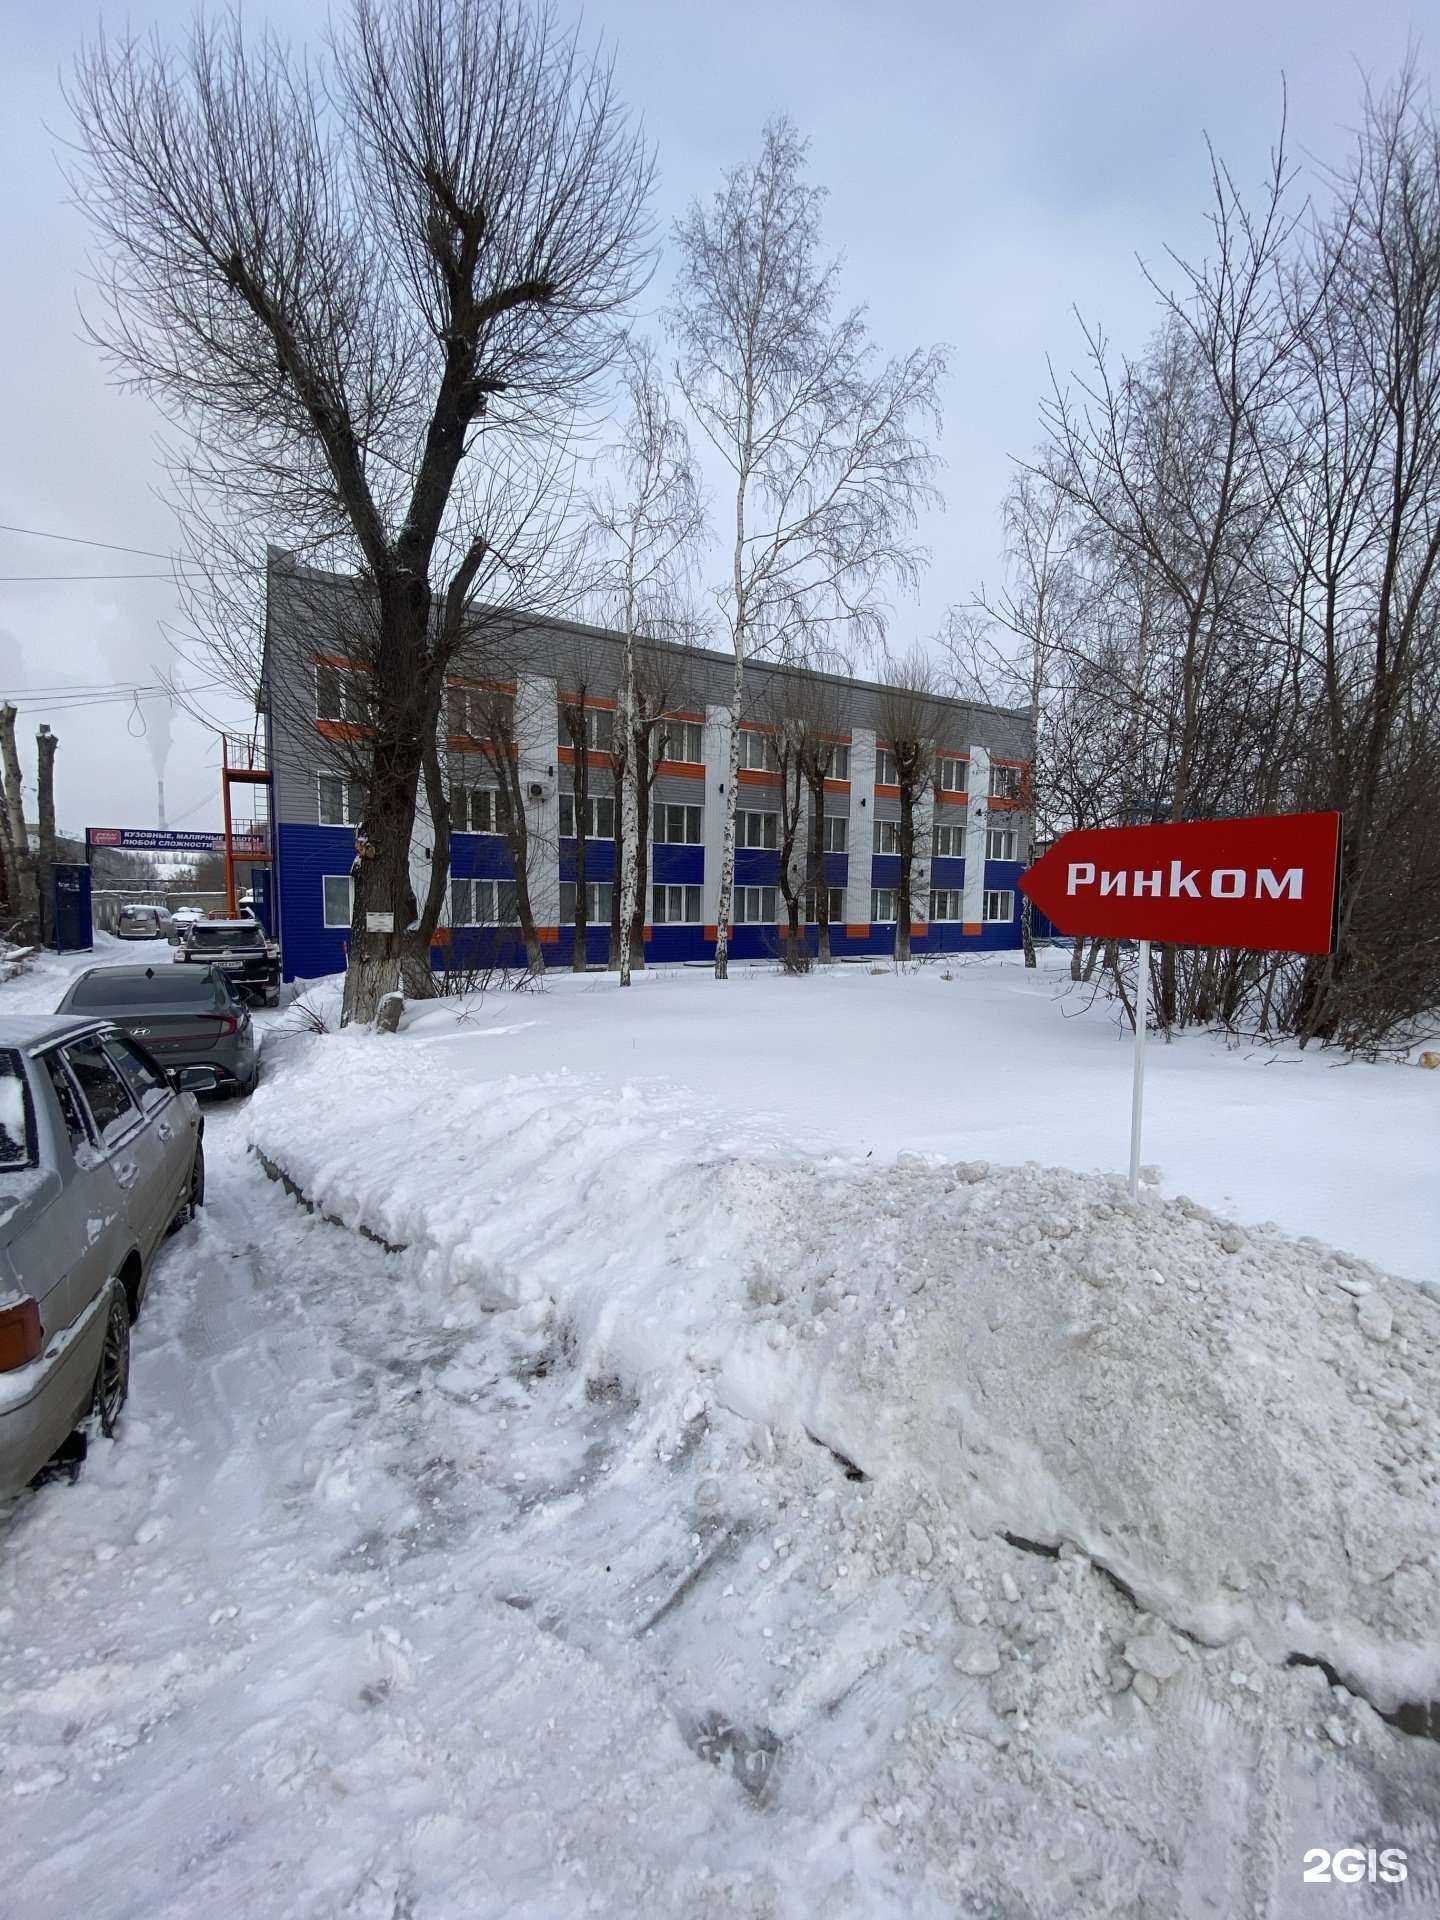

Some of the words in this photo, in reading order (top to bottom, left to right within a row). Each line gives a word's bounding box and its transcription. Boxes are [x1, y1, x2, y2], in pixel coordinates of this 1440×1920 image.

[124, 831, 174, 840] КУЗОВНЫЕ,
[176, 833, 225, 841] МАЛЯРНЫЕ
[158, 840, 213, 848] СЛОЖНОСТИ
[1066, 860, 1304, 900] Ринком
